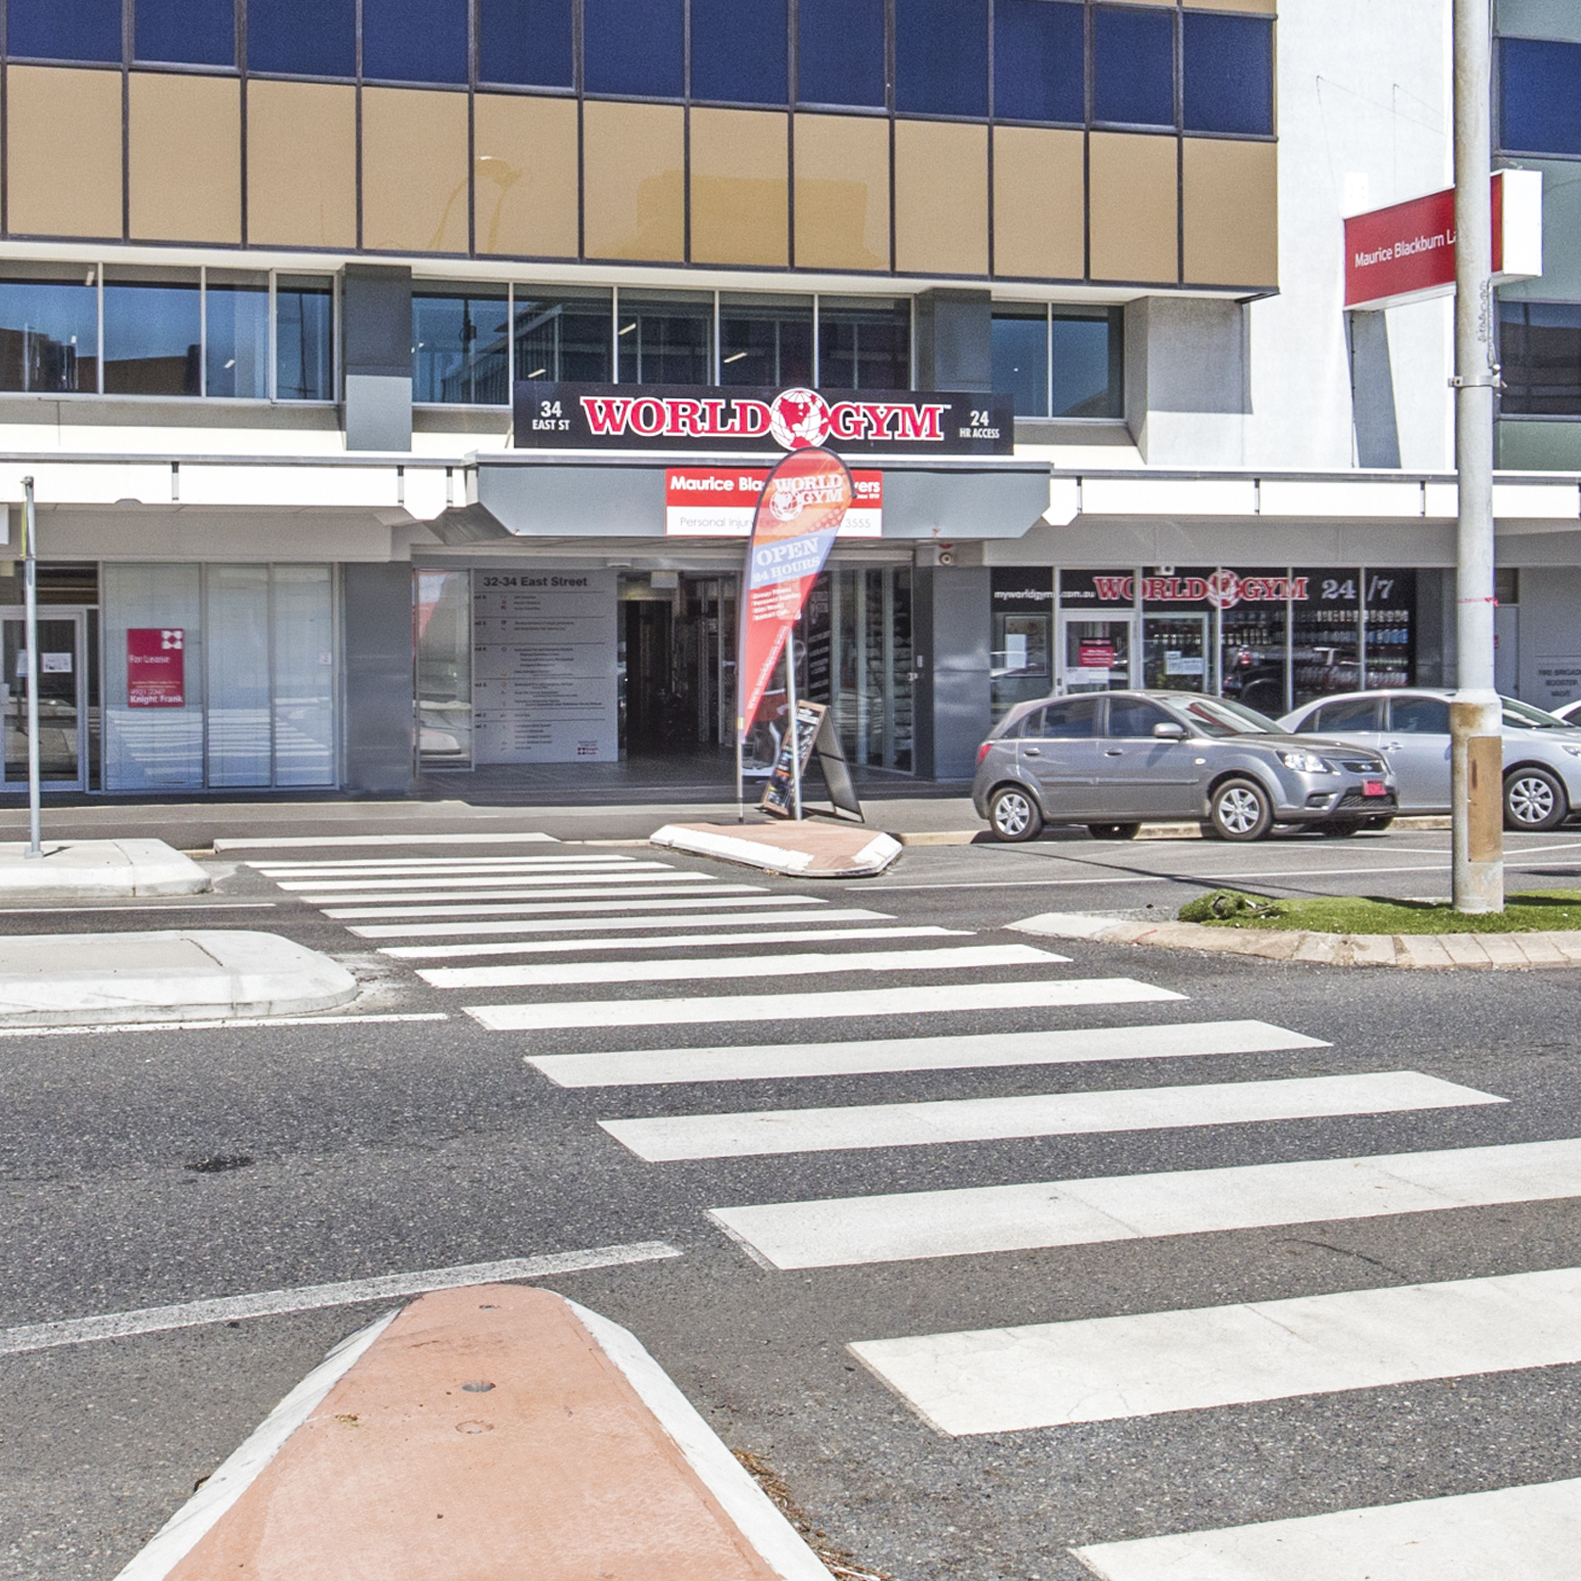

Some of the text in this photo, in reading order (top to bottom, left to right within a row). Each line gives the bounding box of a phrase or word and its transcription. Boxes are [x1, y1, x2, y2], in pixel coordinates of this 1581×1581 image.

[1355, 247, 1393, 268] Maurice
[1394, 235, 1445, 258] Blackburn
[540, 401, 562, 417] 34
[532, 419, 570, 431] EAST ST
[580, 396, 945, 441] WORLD GYM
[970, 410, 990, 426] 24
[959, 427, 1000, 439] HR ACCESS
[670, 476, 734, 491] Maurice
[773, 474, 843, 492] WORLD
[798, 488, 844, 507] GYM
[680, 517, 725, 527] Personal
[845, 518, 871, 528] 3555
[756, 537, 820, 566] OPEN
[752, 556, 822, 583] 24 HOURS
[483, 577, 588, 587] 32-34 East Street
[1093, 576, 1210, 601] WORLD
[1239, 576, 1309, 601] GYM
[143, 655, 170, 663] Lease
[130, 695, 183, 705] Knight Frank
